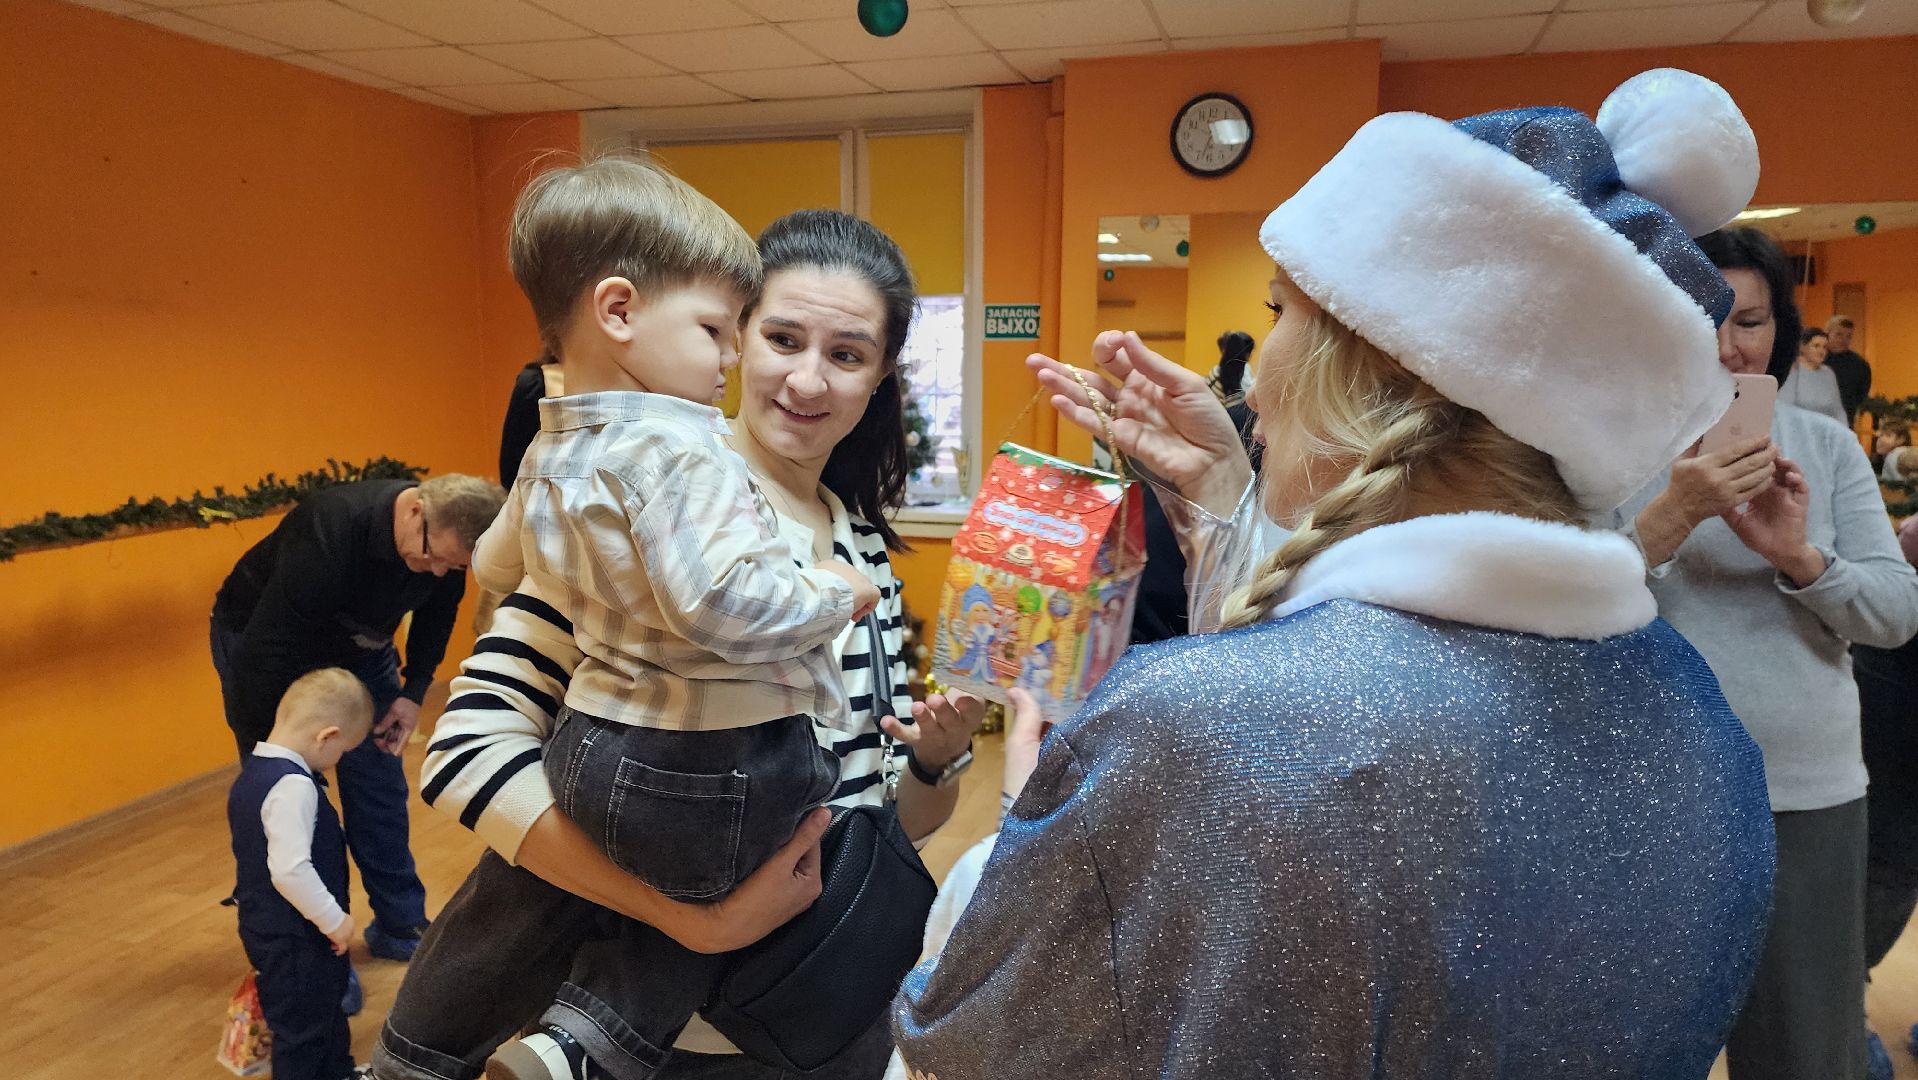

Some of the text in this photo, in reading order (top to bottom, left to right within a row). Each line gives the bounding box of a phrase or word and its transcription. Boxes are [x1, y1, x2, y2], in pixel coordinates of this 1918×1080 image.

[1208, 107, 1218, 119] 12
[986, 308, 1040, 318] ЗАПАСНЫ
[986, 318, 1040, 336] ВЫХО
